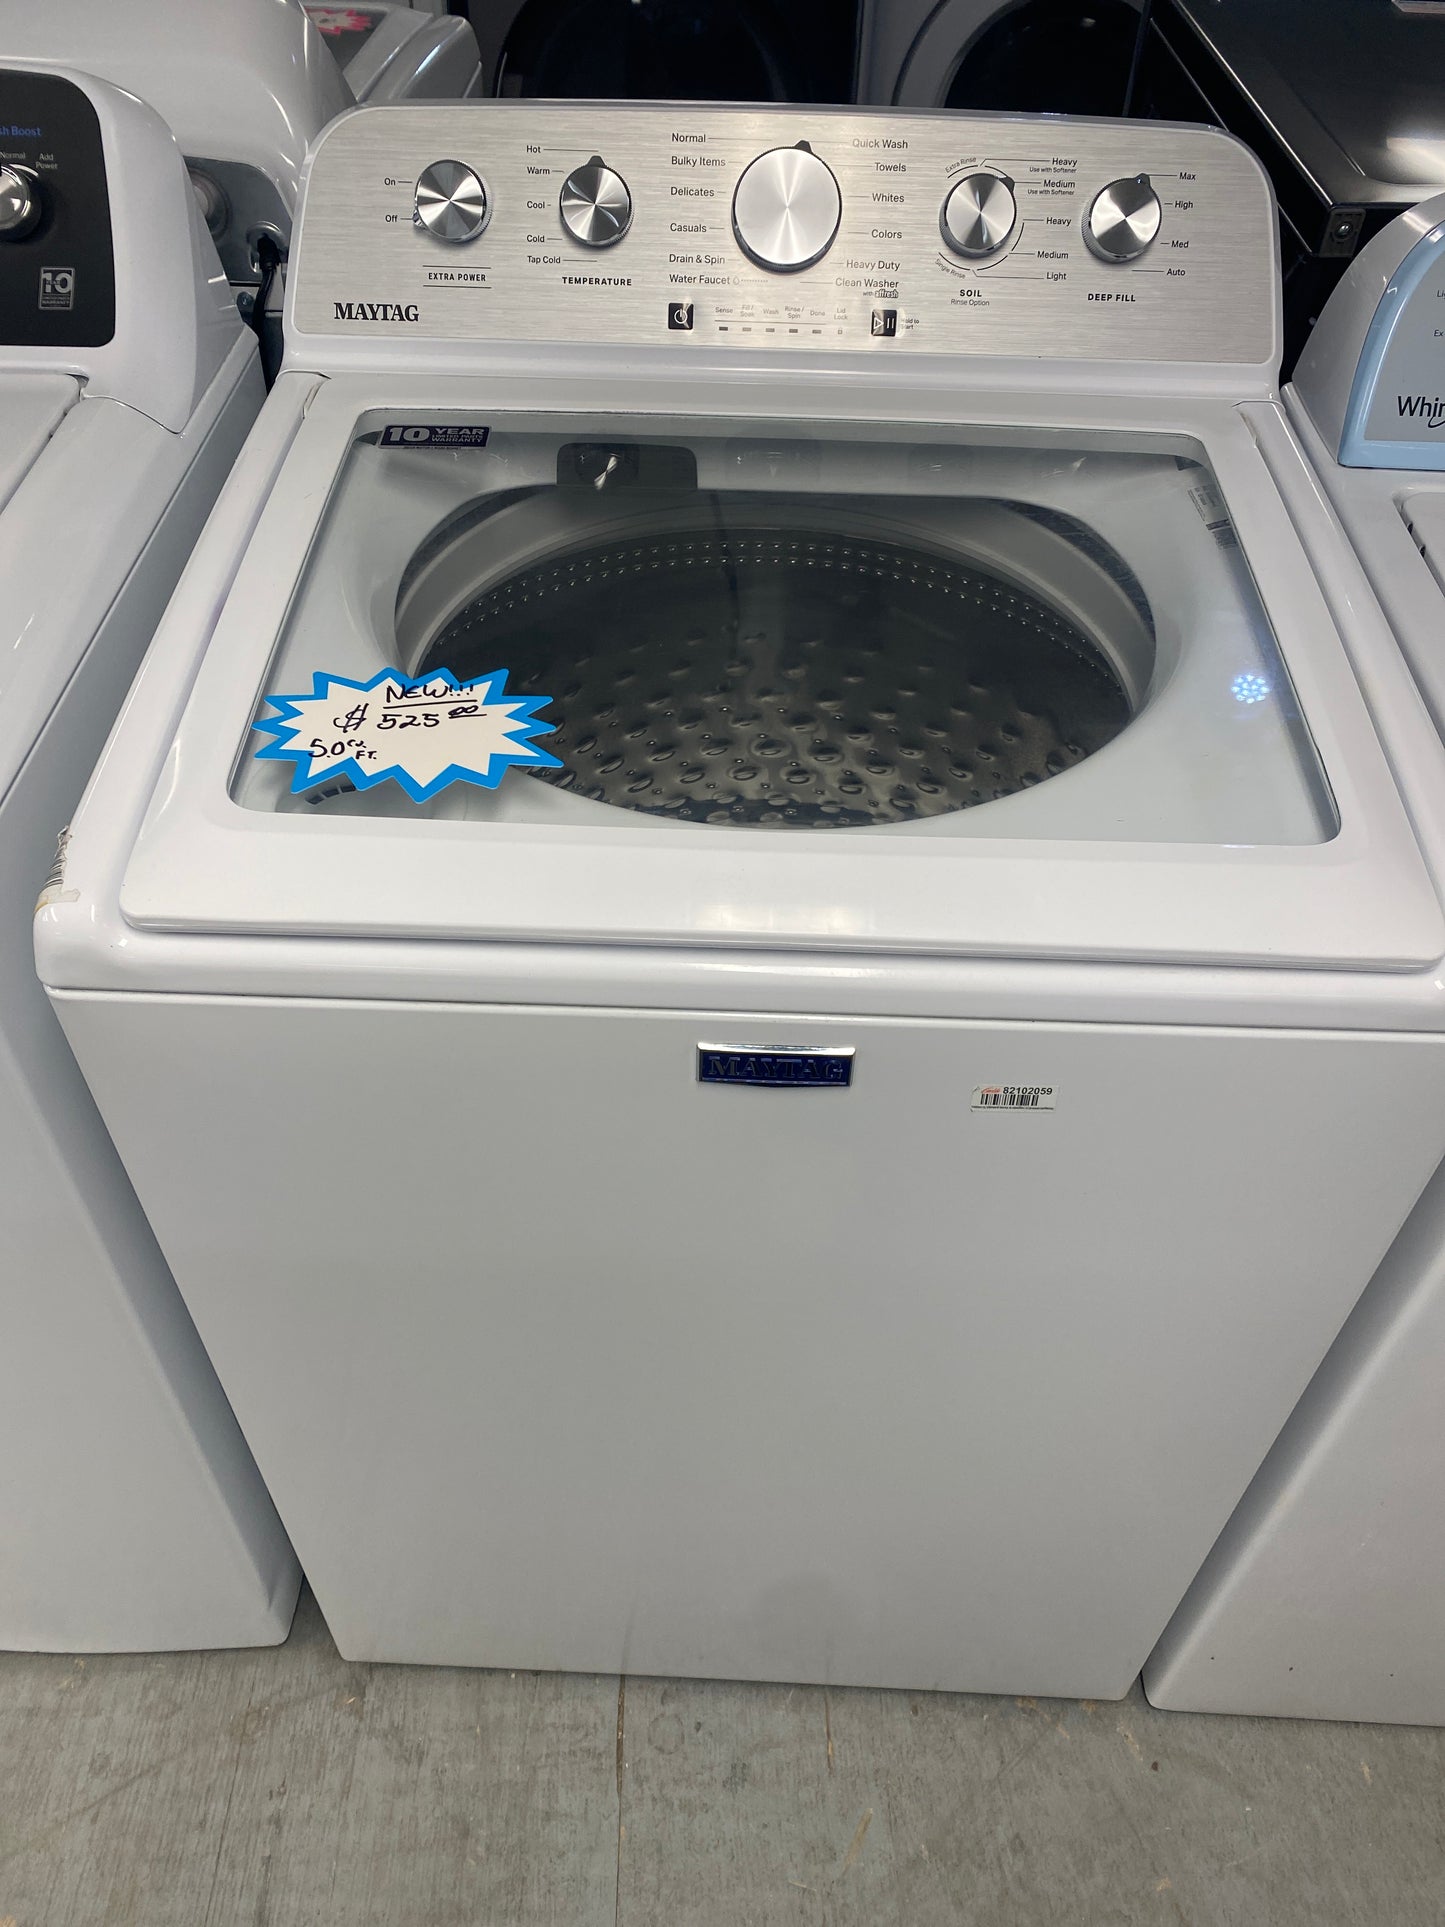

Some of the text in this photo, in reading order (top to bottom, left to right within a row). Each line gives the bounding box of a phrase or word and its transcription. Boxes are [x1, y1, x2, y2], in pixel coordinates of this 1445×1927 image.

[11, 125, 42, 136] Boost
[671, 133, 706, 143] Normal
[526, 145, 541, 153] Hot
[852, 139, 908, 149] Quick Wash
[671, 156, 726, 167] Bulky Items
[1052, 157, 1078, 167] Heavy
[527, 166, 550, 175] Warm
[875, 162, 907, 172] Towels
[945, 161, 961, 173] Extra
[1179, 172, 1196, 180] Max
[384, 177, 396, 186] On
[1043, 179, 1076, 188] Medium
[670, 187, 715, 197] Delicates
[872, 193, 905, 203] Whites
[527, 201, 545, 209] Cool
[1174, 201, 1193, 210] High
[385, 214, 398, 223] Off
[1046, 217, 1072, 227] Heavy
[670, 223, 707, 233] Casuals
[527, 235, 545, 243] Cold
[871, 229, 902, 239] Colors
[1171, 240, 1189, 248] Med
[1037, 249, 1069, 259] Medium
[527, 256, 561, 265] Tap Cold
[669, 254, 725, 265] Drain & Spin
[846, 259, 900, 272] Heavy Duty
[935, 258, 966, 279] Single Rinse
[1046, 272, 1067, 282] Light
[1167, 268, 1186, 276] Auto
[428, 273, 486, 282] EXTRA POWER
[562, 276, 632, 286] TEMPERATURE
[669, 274, 730, 285] Water Faucet
[835, 277, 899, 288] Clean Washer
[42, 272, 72, 294] 10
[875, 288, 899, 299] affresh
[959, 289, 982, 297] SOIL
[1087, 293, 1136, 302] DEEP FILL
[969, 299, 990, 307] Option
[333, 302, 419, 322] MAYTAG
[788, 312, 801, 320] Spin
[809, 309, 826, 317] Done
[1434, 329, 1445, 337] Ex
[389, 427, 430, 442] 10
[386, 684, 474, 704] NEW!!!
[333, 703, 370, 734] $
[377, 713, 441, 730] 525
[708, 1056, 844, 1080] MAYTAG
[1003, 1086, 1053, 1095] 82102059
